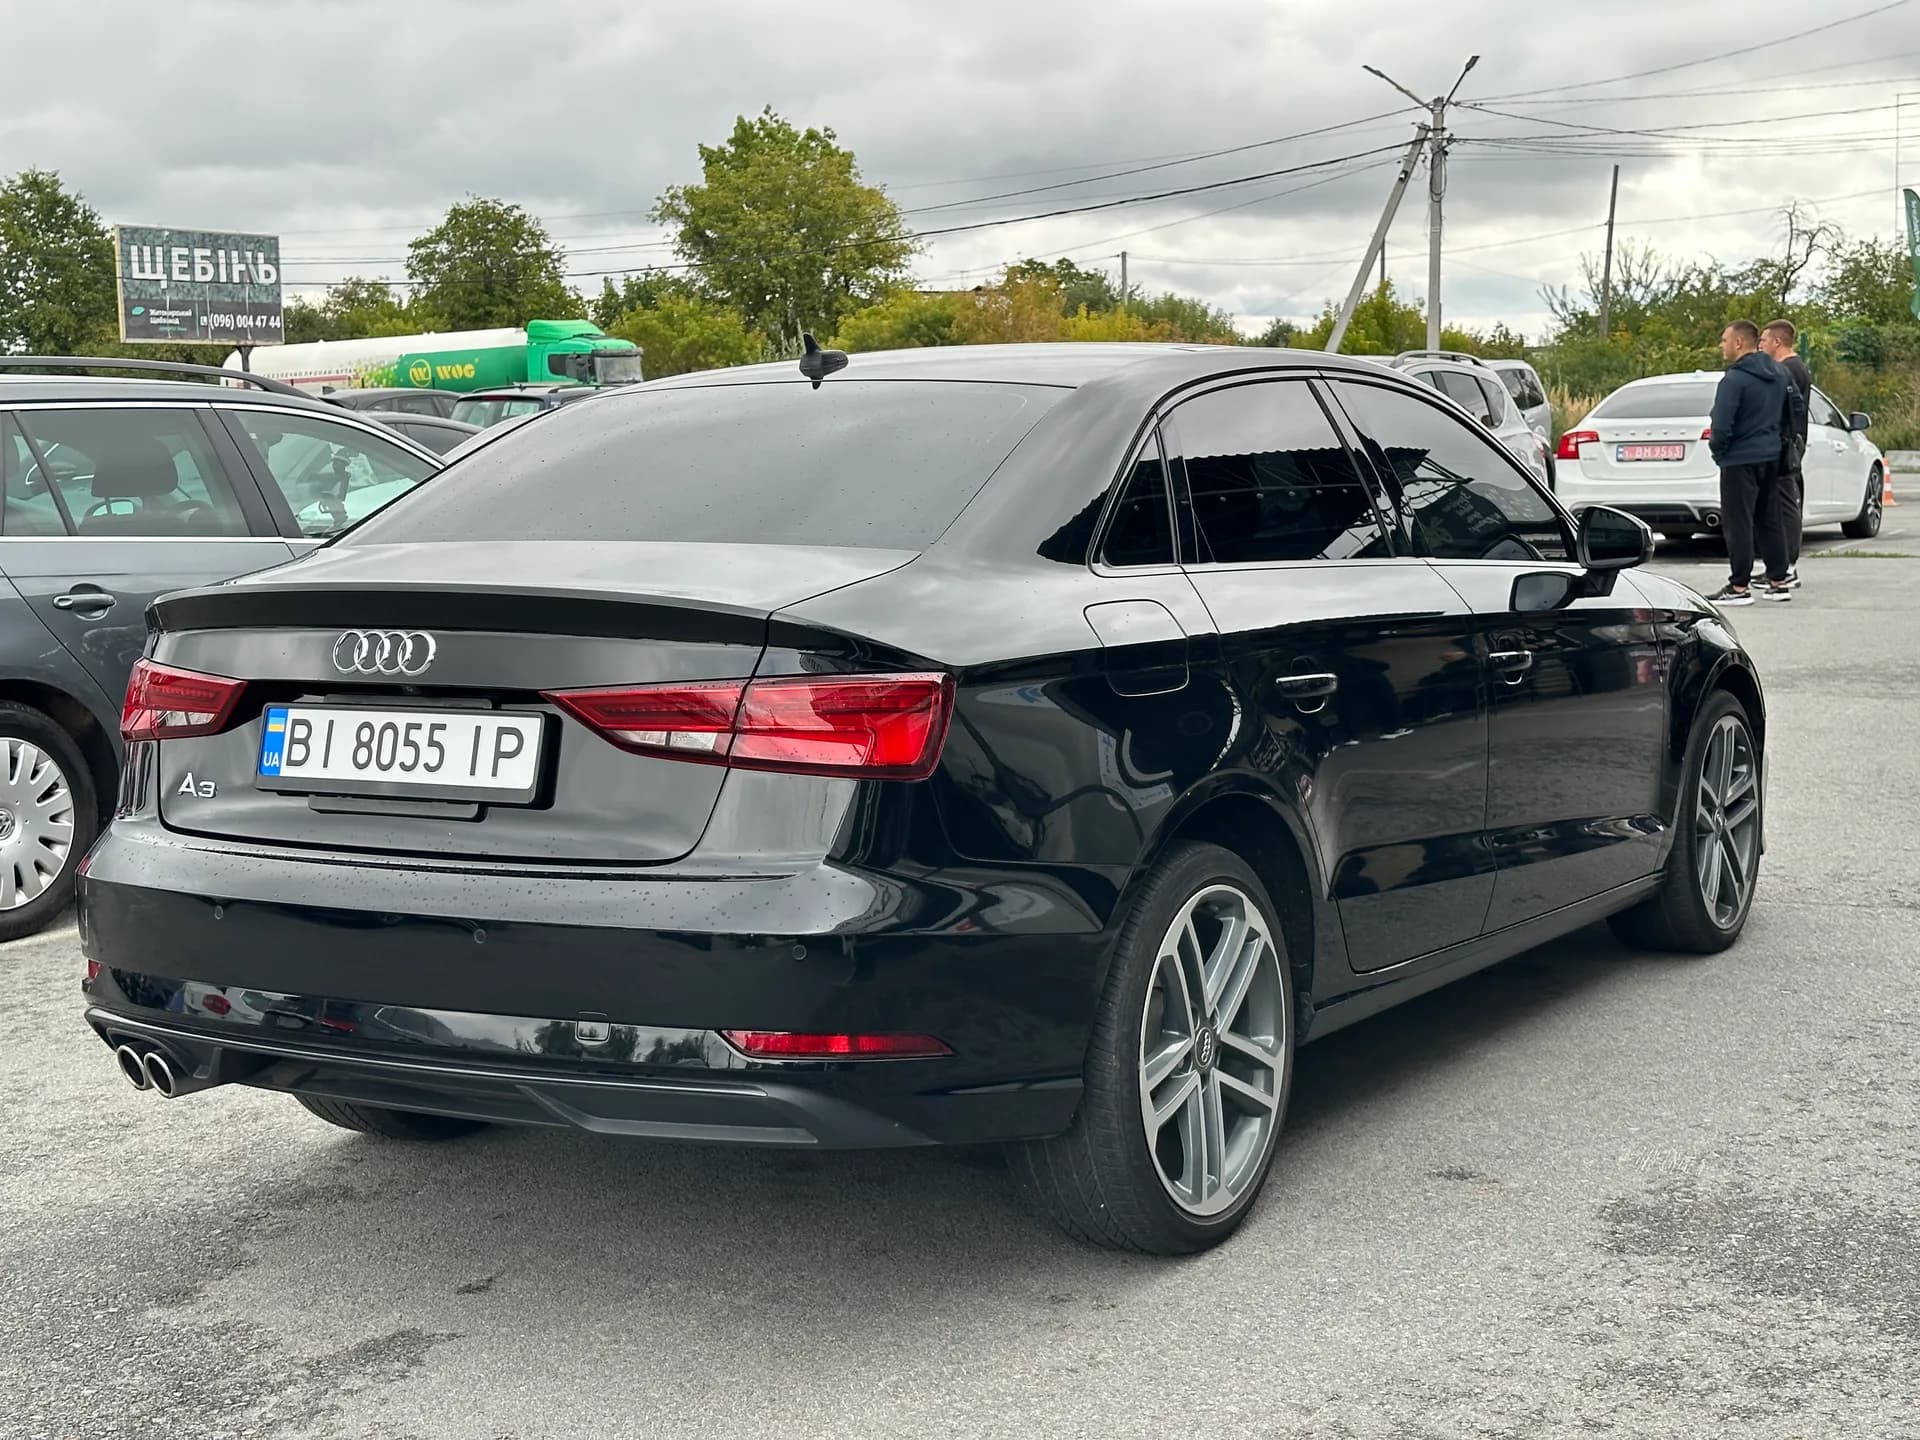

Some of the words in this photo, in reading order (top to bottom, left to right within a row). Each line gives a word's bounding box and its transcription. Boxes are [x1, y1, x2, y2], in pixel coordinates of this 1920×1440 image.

[130, 245, 277, 289] ЩЕБІНЬ
[210, 313, 234, 331] (096)
[236, 314, 253, 328] 004
[255, 315, 267, 328] 47
[269, 315, 281, 328] 44
[435, 364, 475, 380] WOG
[285, 718, 333, 769] BI
[352, 721, 447, 773] 8055
[469, 725, 524, 777] IP
[263, 751, 280, 768] UA
[177, 772, 217, 798] A3
